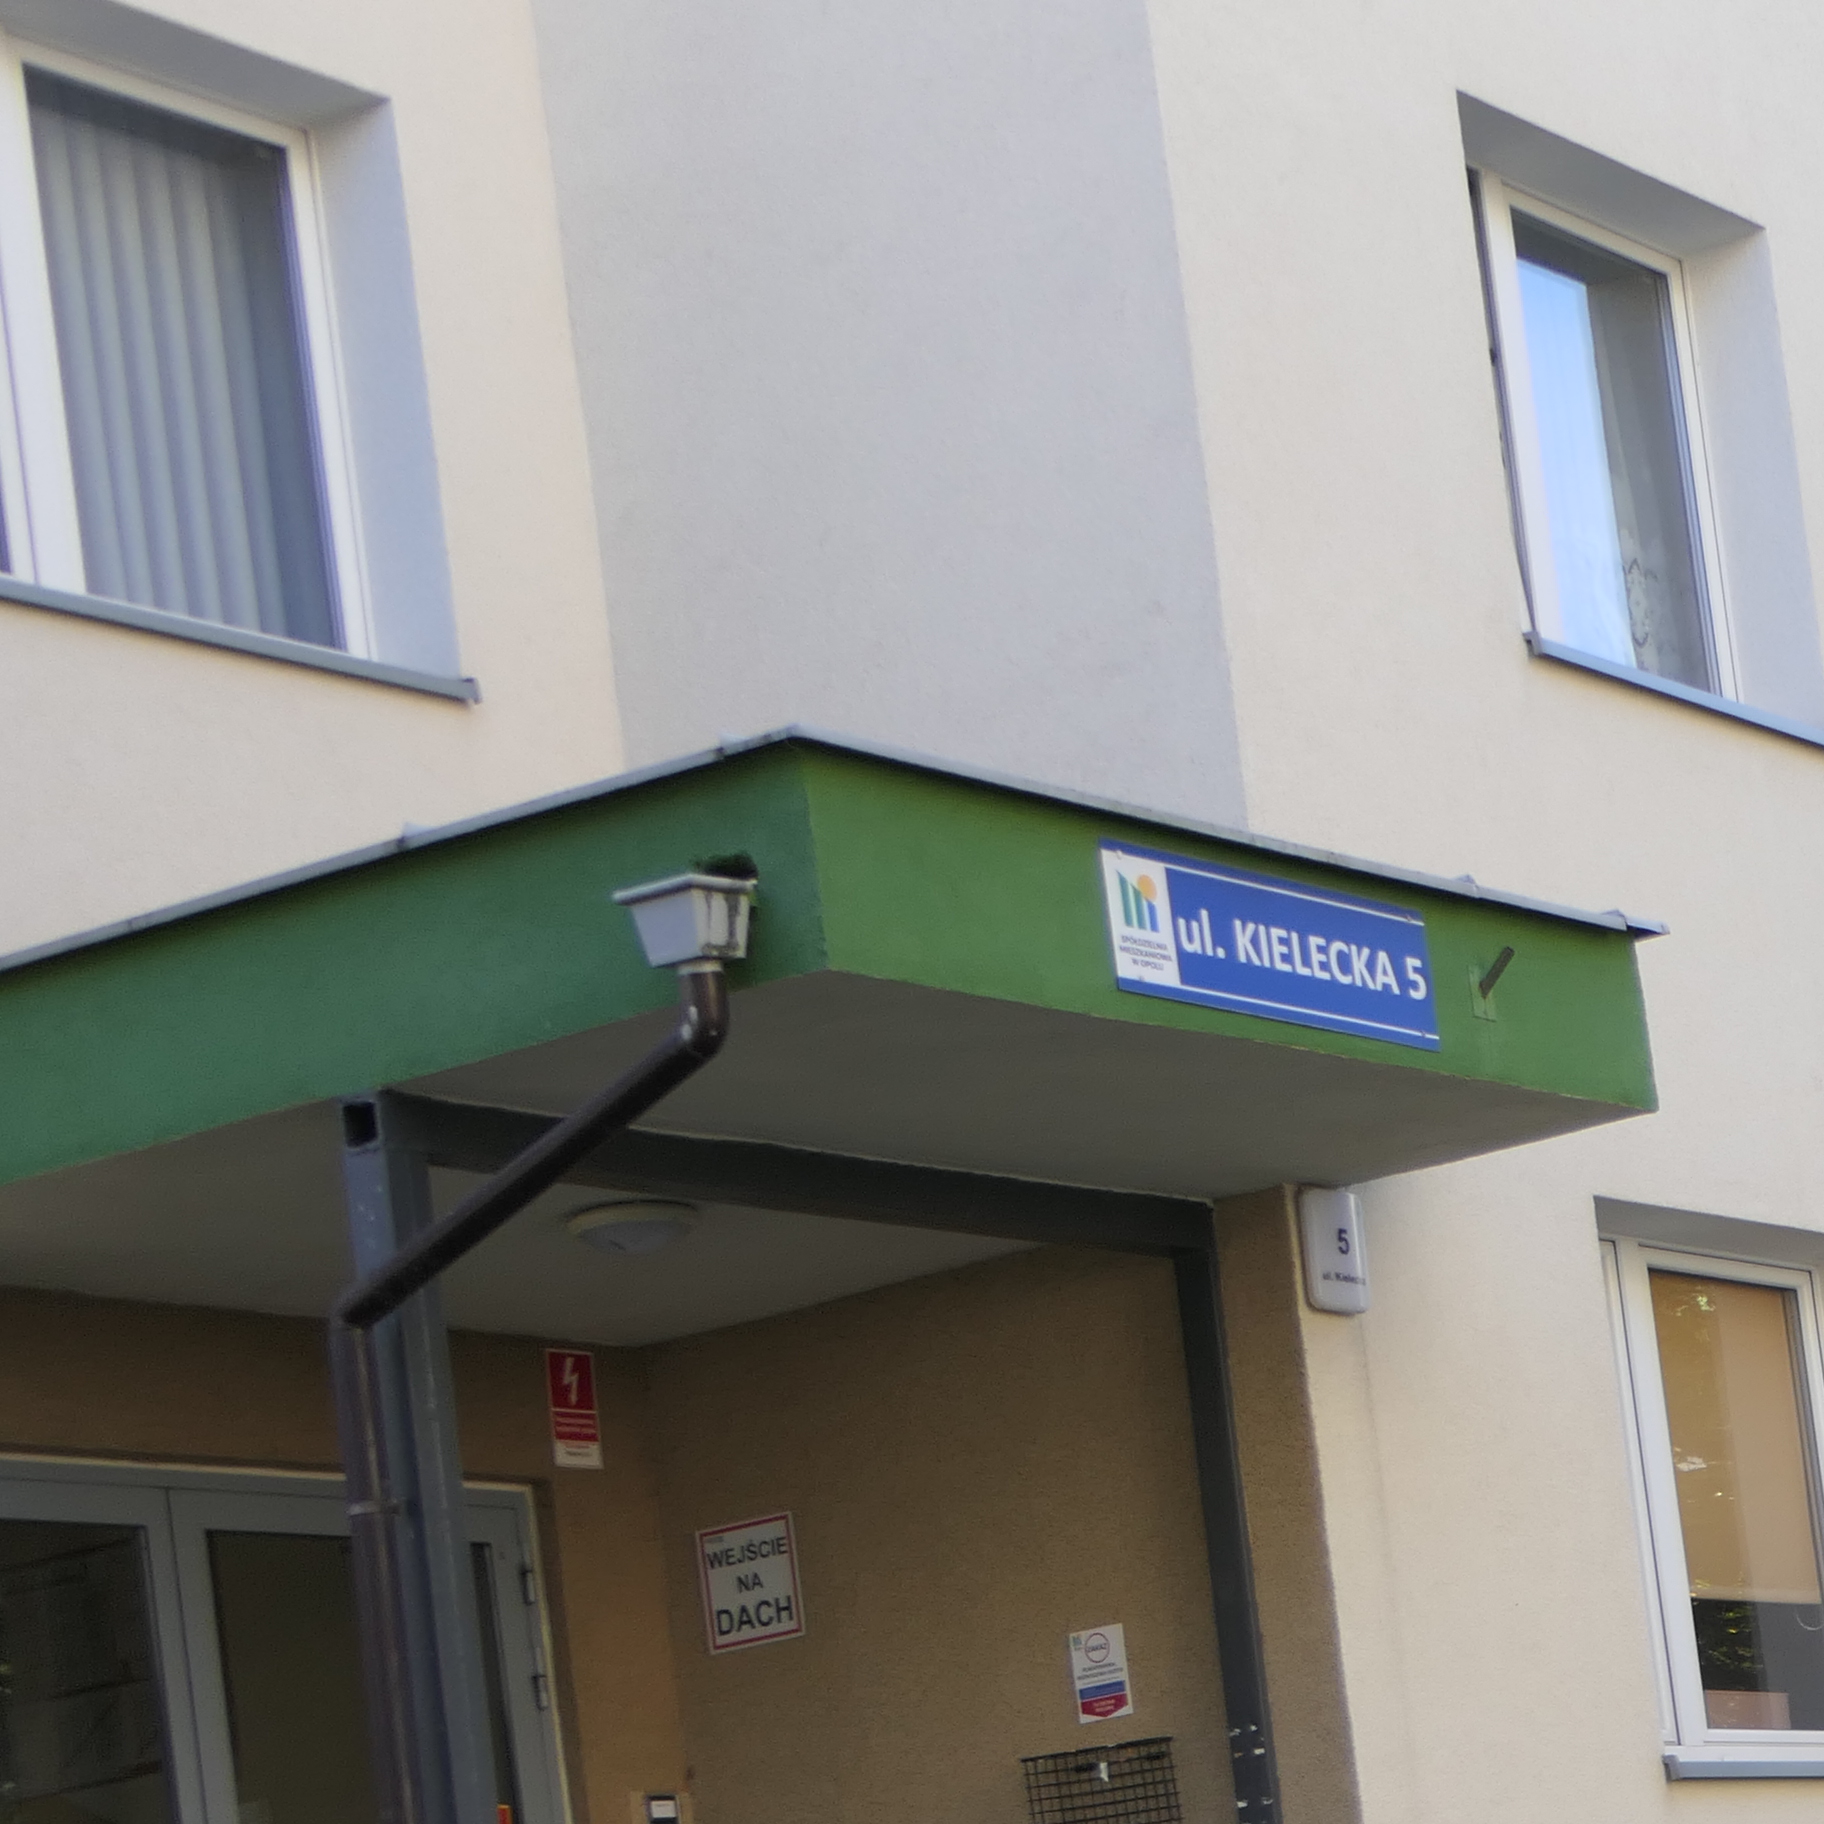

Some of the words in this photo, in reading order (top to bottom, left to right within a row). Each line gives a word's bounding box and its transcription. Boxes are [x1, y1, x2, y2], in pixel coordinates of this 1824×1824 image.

[1177, 907, 1226, 959] ul.
[1233, 918, 1401, 995] KIELECKA
[1405, 956, 1428, 1001] 5
[1337, 1228, 1350, 1255] 5
[736, 1572, 763, 1593] NA
[716, 1595, 794, 1636] DACH
